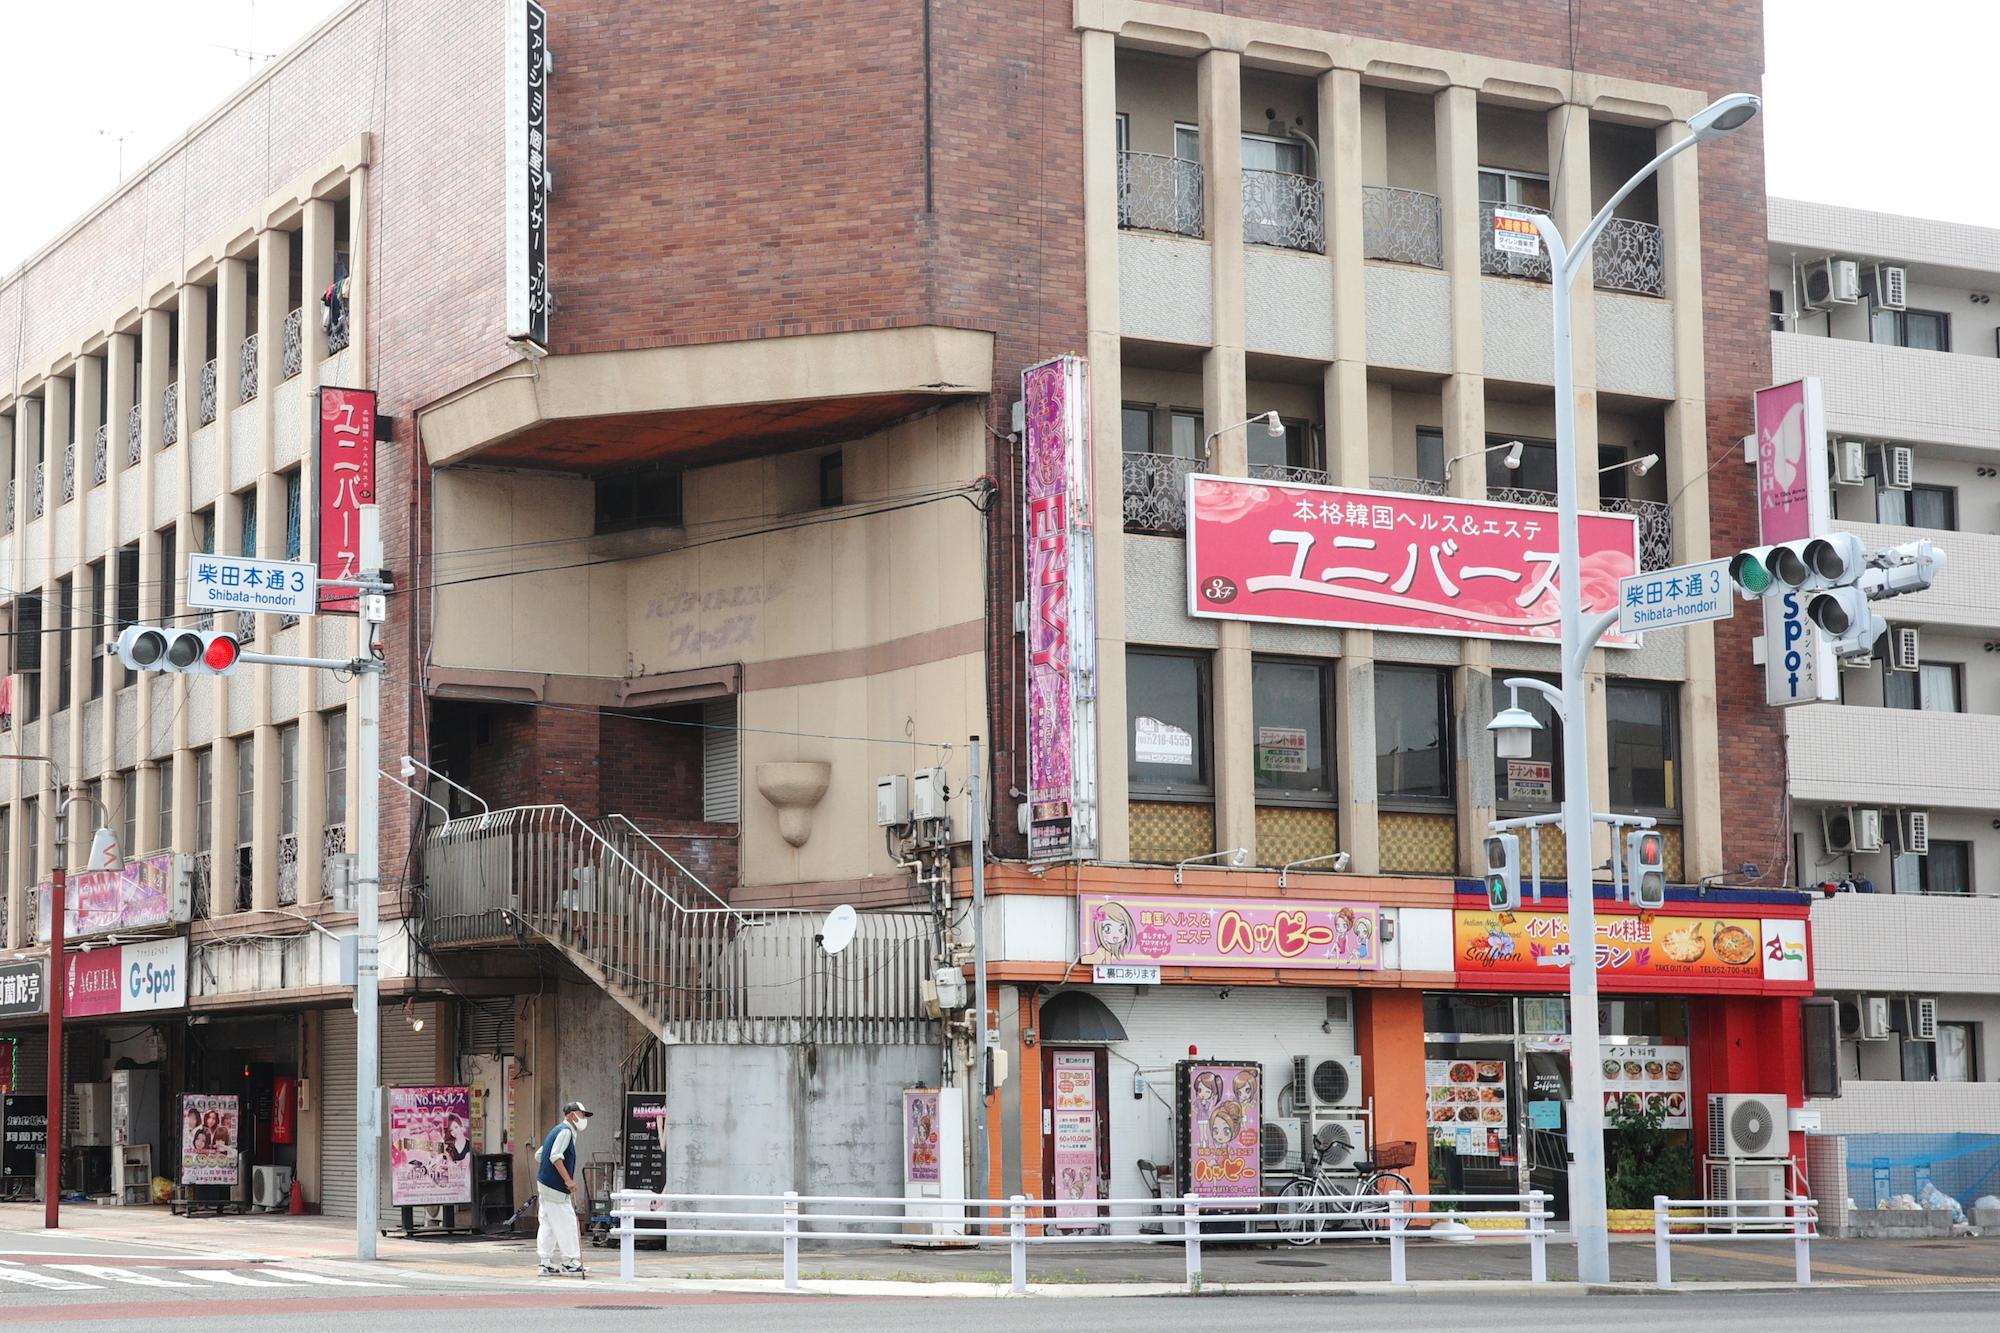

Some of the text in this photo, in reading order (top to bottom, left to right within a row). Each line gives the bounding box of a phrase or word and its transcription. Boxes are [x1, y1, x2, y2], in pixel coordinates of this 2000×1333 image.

[536, 261, 545, 314] マリン
[528, 275, 539, 329] ブルー
[1761, 427, 1776, 509] AGEHA
[332, 404, 361, 581] ユニバース
[1292, 499, 1542, 539] 本格韓国ヘルス&エステ
[1245, 528, 1593, 612] ユニバース
[208, 588, 296, 606] Shibata-hondori
[1031, 494, 1068, 680] ENVY
[1206, 579, 1233, 599] 3F
[1633, 597, 1717, 624] Shibata-hondori
[1783, 592, 1803, 697] Spot
[1509, 765, 1550, 779] テナント募集
[1176, 929, 1212, 945] エステ
[1216, 909, 1334, 958] ハッピー
[1526, 917, 1652, 942] インド・ール料理
[1464, 946, 1523, 968] Saffron
[1553, 944, 1632, 968] サラン
[79, 968, 118, 994] AGEHA
[1106, 967, 1158, 979] 裏口あります
[1195, 1157, 1257, 1182] ハッピー
